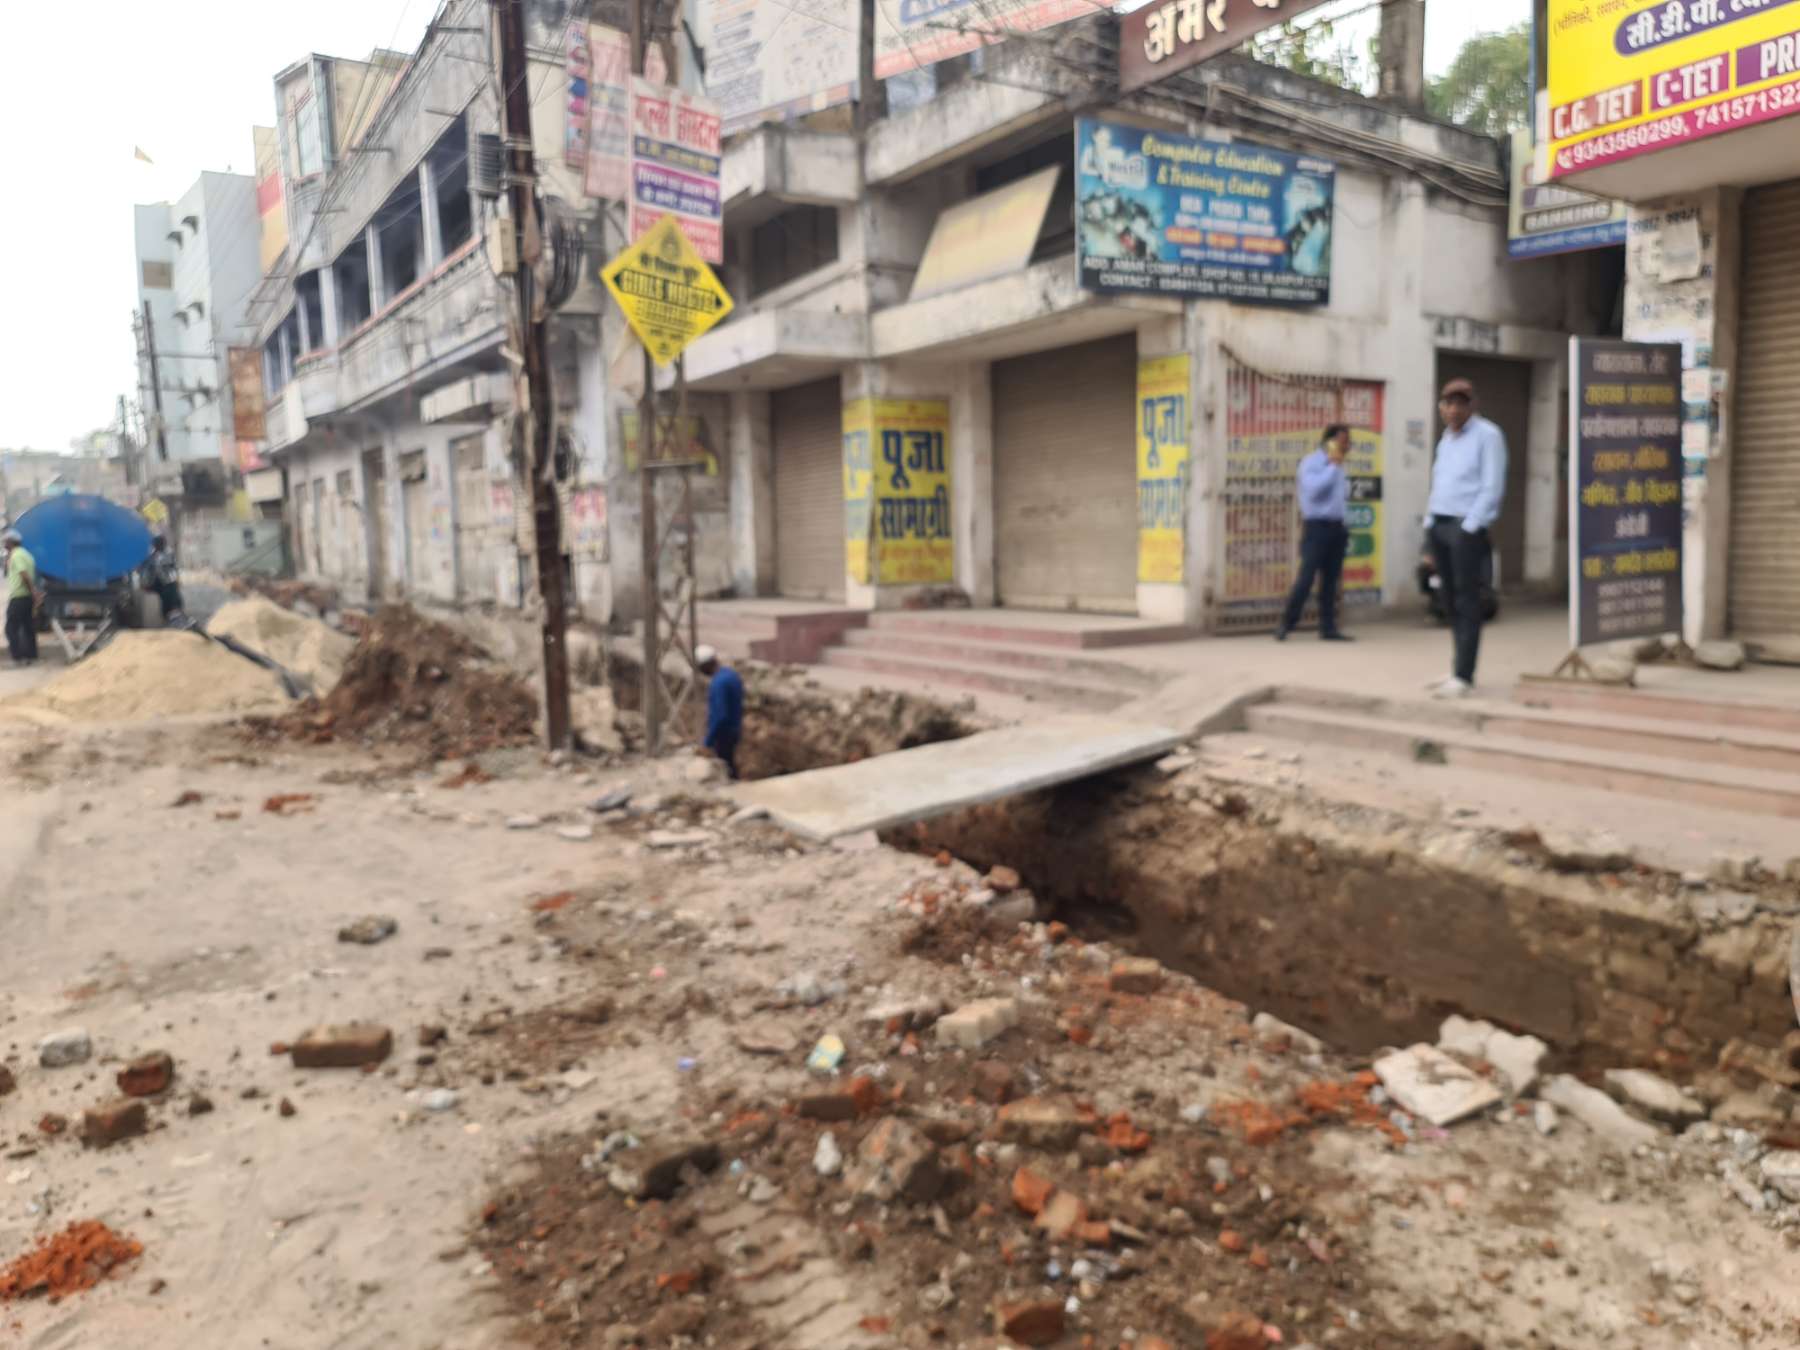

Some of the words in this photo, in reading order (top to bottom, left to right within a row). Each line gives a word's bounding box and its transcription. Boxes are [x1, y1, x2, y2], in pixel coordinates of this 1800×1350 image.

[1143, 0, 1227, 64] अमर
[1595, 82, 1638, 124] TET
[1656, 56, 1724, 108] C-TET
[881, 429, 945, 490] पूजा
[1141, 394, 1185, 468] पूजा
